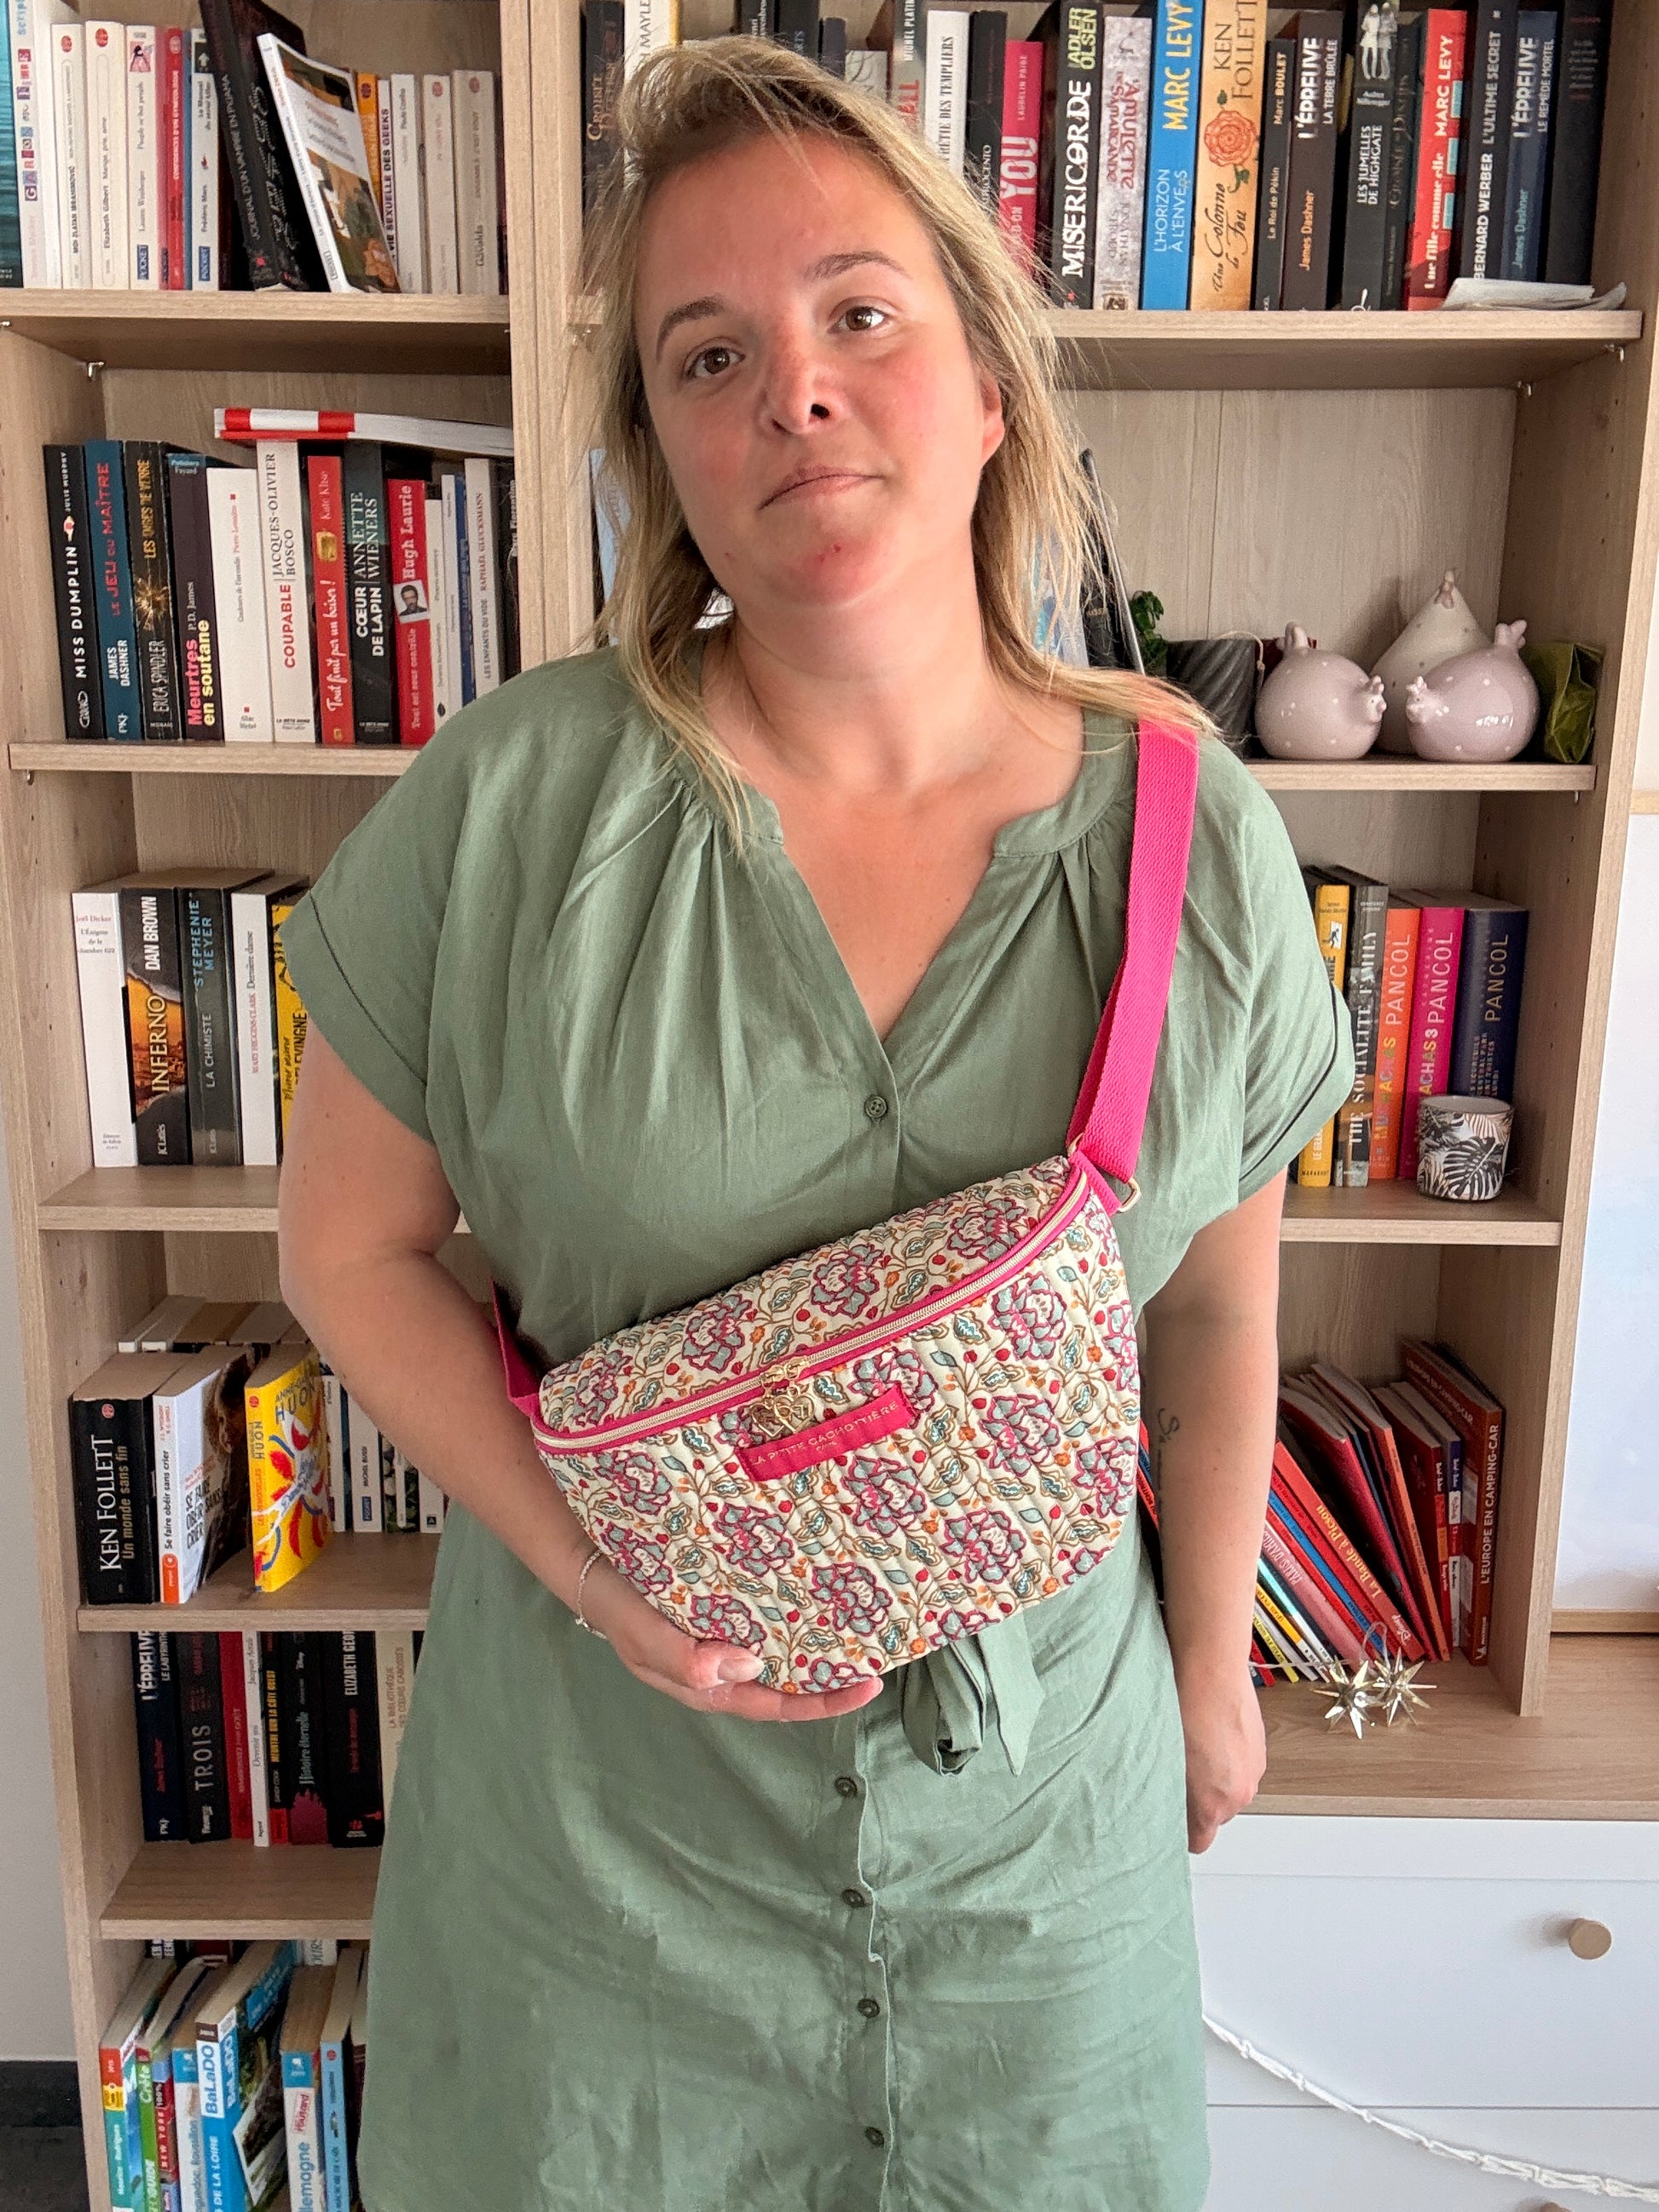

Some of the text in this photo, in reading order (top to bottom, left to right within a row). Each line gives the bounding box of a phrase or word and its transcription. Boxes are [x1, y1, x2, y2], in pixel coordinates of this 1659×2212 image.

[902, 32, 914, 62] MICHEL
[1066, 7, 1083, 63] ADLER
[1081, 9, 1097, 69] OLSEN
[1162, 0, 1194, 130] MARC LEVY
[1212, 22, 1233, 71] KEN
[1233, 0, 1258, 100] FOLLETT
[939, 37, 954, 119] DES TEMPLIERS
[1273, 52, 1287, 124] Marc BOULET
[1294, 37, 1320, 138] L'ÉPREUVE
[1322, 38, 1338, 124] LA TERRE BRÛLÉE
[1433, 34, 1453, 136] MARC LEVY
[1481, 31, 1500, 144] L'ULTIME SECRET
[1511, 37, 1536, 138] L'ÉPREUVE
[1536, 38, 1554, 132] LE REMÈDE MORTEL
[380, 108, 394, 230] SEXUELLE DES GEEKS
[1001, 136, 1038, 199] YOU
[1061, 80, 1091, 278] MISERICORDE
[1356, 125, 1372, 204] LES JUMELLES
[1367, 124, 1383, 205] DE HIGHGATE
[1153, 169, 1171, 252] L'HORIZON
[1204, 183, 1227, 292] Une Colonne
[1225, 211, 1248, 269] de Feu
[1267, 166, 1280, 239] Le Roi de Pékin
[1298, 190, 1315, 271] James Dashner
[1424, 153, 1444, 289] Une fille comme elle
[1473, 153, 1494, 280] BERNARD WERBER
[1512, 188, 1529, 269] James Dashner
[200, 247, 209, 280] POCKET
[1169, 242, 1185, 252] À
[60, 451, 72, 512] JULIE MURPHY
[136, 459, 156, 559] LES VERRE
[265, 453, 284, 577] JACQUES-OLIVIER
[95, 462, 120, 615] LE JEU DU MAÎTRE
[283, 529, 297, 575] BOSCO
[350, 492, 367, 579] ANNETTE
[363, 498, 380, 579] WIENERS
[399, 485, 417, 579] Hugh Laurie
[475, 492, 485, 552] GLUCKSMANN
[64, 546, 87, 679] MISS DUMPLIN
[185, 581, 197, 632] P.D. James
[279, 584, 297, 668] COUPABLE
[355, 586, 368, 638] CŒUR
[369, 586, 384, 656] DE LAPIN
[480, 598, 491, 663] ENFANTS DU VIDE
[107, 647, 118, 680] JAMES
[117, 639, 130, 687] DASHNER
[148, 640, 170, 713] ERICA SPINDLER
[184, 638, 203, 725] Meurtres
[196, 620, 215, 726] en soutane
[322, 588, 348, 711] Tout finit par un baiser
[141, 896, 161, 971] DAN BROWN
[188, 900, 205, 987] STEPHENIE
[201, 917, 214, 971] MEYER
[1384, 934, 1411, 1025] PANCOL
[1427, 933, 1454, 1024] PANCOL
[1484, 934, 1508, 1022] PANCOL
[147, 996, 171, 1092] INFERNO
[201, 1014, 216, 1089] LA CHIMISTE
[1347, 932, 1378, 1146] THE SOCIALITE FAMILY
[161, 1450, 170, 1470] crier
[254, 1421, 265, 1459] HUON
[90, 1434, 122, 1572] KEN FOLLETT
[115, 1446, 136, 1560] Un monde sans fin
[162, 1493, 171, 1516] obéir
[163, 1517, 172, 1538] faire
[1316, 1505, 1343, 1542] Picsou
[1480, 1424, 1500, 1585] L'EUROPE EN CAMPING-CAR
[164, 1539, 172, 1550] Se
[1281, 1557, 1304, 1585] PARIS
[1338, 1538, 1349, 1551] à
[1346, 1546, 1371, 1583] Bande
[1369, 1577, 1383, 1599] La
[160, 1672, 170, 1682] LE
[246, 1659, 257, 1685] Jacques
[343, 1654, 358, 1695] ELIZABETH
[385, 1666, 396, 1729] LA BIBLIOTHÈQUE
[191, 1724, 214, 1792] TROIS
[158, 2111, 168, 2169] NEW YORK
[209, 2135, 223, 2206] DE LA LOIRE
[298, 2140, 314, 2212] llemagne
